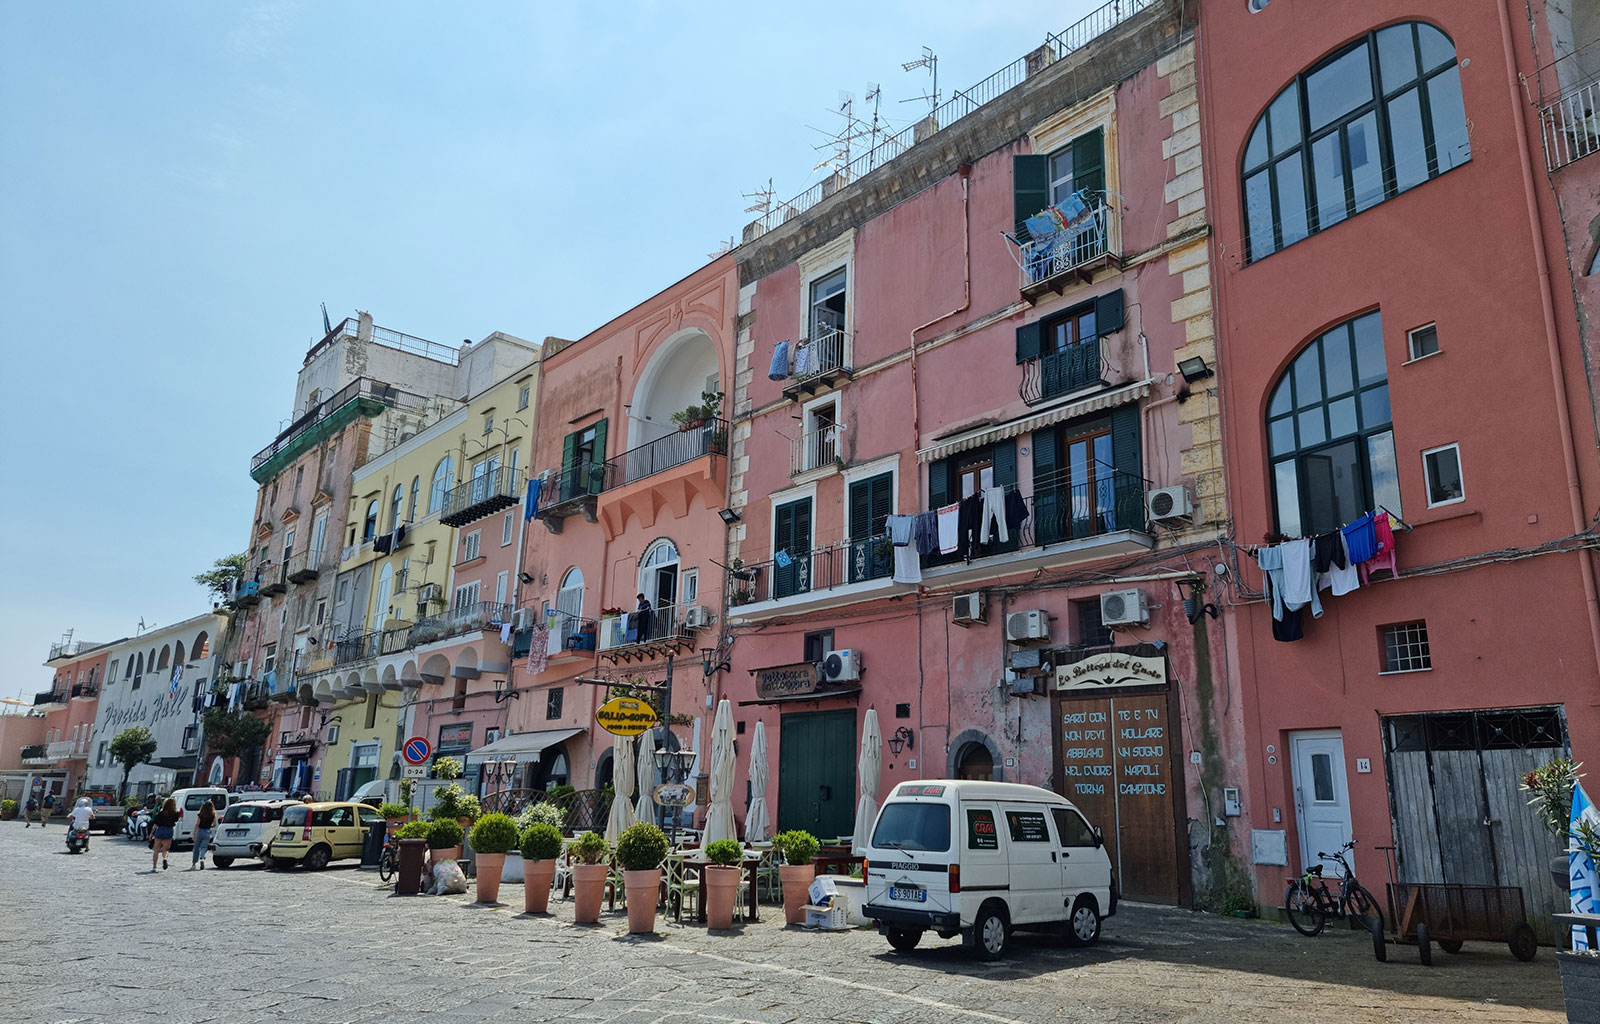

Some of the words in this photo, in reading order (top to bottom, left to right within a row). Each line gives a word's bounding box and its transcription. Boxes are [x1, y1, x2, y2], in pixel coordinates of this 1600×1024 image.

[1058, 674, 1071, 687] La
[1072, 661, 1111, 679] Bottega
[1112, 659, 1130, 669] del
[1131, 661, 1162, 679] Gusto
[102, 698, 147, 734] Procida
[149, 686, 190, 727] Hall
[1088, 711, 1107, 723] CON
[1117, 709, 1131, 721] TE
[1133, 709, 1141, 721] E
[1064, 730, 1082, 741] NON
[1084, 729, 1106, 740] DEVI
[1120, 727, 1164, 739] MOLLARE
[1066, 747, 1104, 758] ABBIAMO
[1132, 745, 1164, 757] SOGNO
[1064, 765, 1082, 776] NEL
[1124, 764, 1160, 776] NAPOLI
[1074, 783, 1105, 795] TORNA
[1119, 783, 1166, 795] CAMPIONE
[891, 862, 920, 871] PIAGGIO
[894, 889, 902, 898] ES
[903, 889, 922, 900] 901AE
